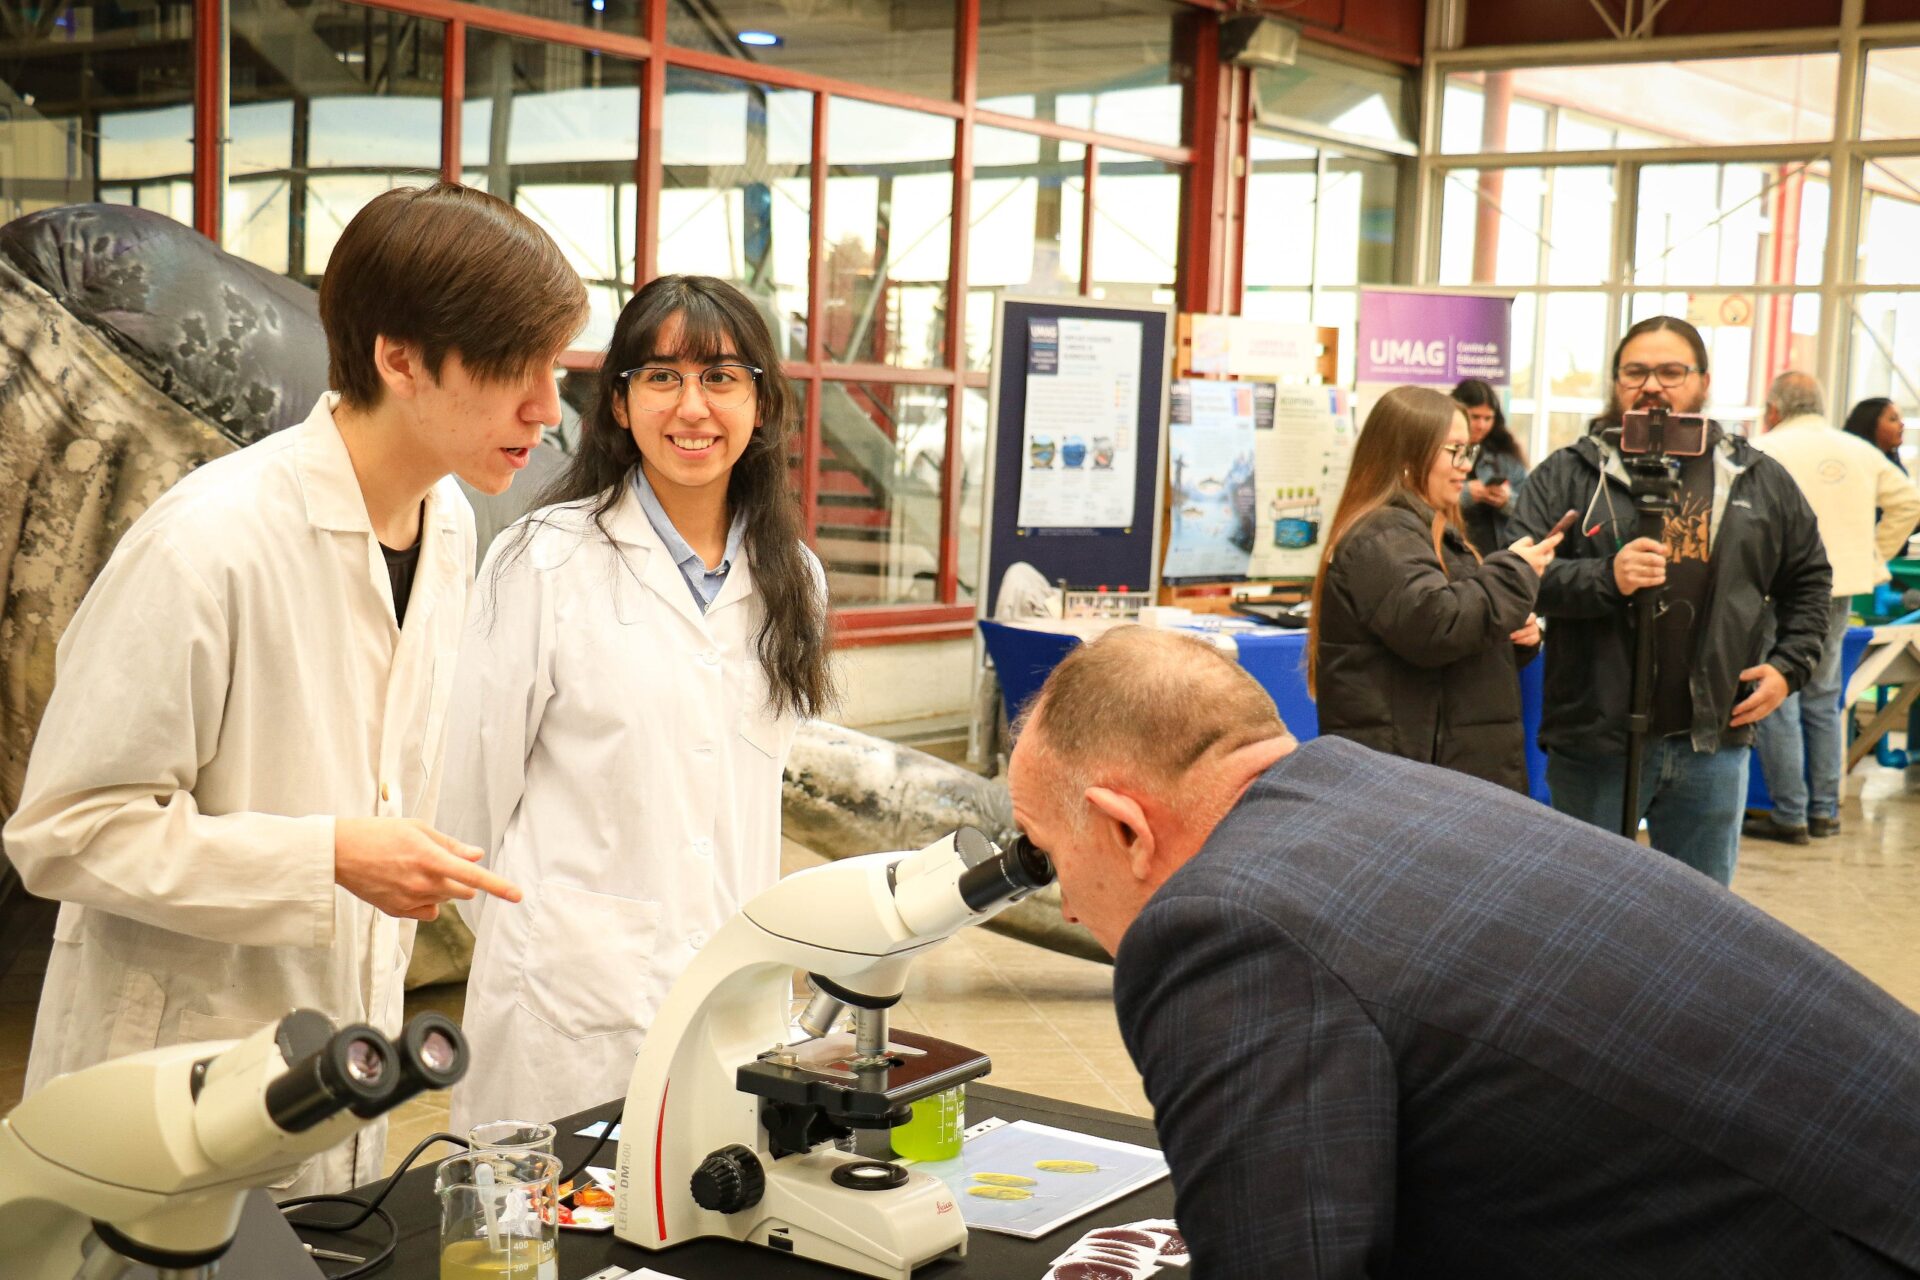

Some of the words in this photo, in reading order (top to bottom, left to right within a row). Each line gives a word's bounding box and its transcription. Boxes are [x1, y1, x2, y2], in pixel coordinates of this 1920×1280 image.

[1370, 338, 1445, 366] UMAG
[620, 1143, 631, 1188] DM500
[618, 1193, 628, 1231] LEICA
[936, 1200, 953, 1215] Leica
[513, 1241, 529, 1250] 400
[542, 1238, 555, 1252] 600
[513, 1263, 529, 1272] 300
